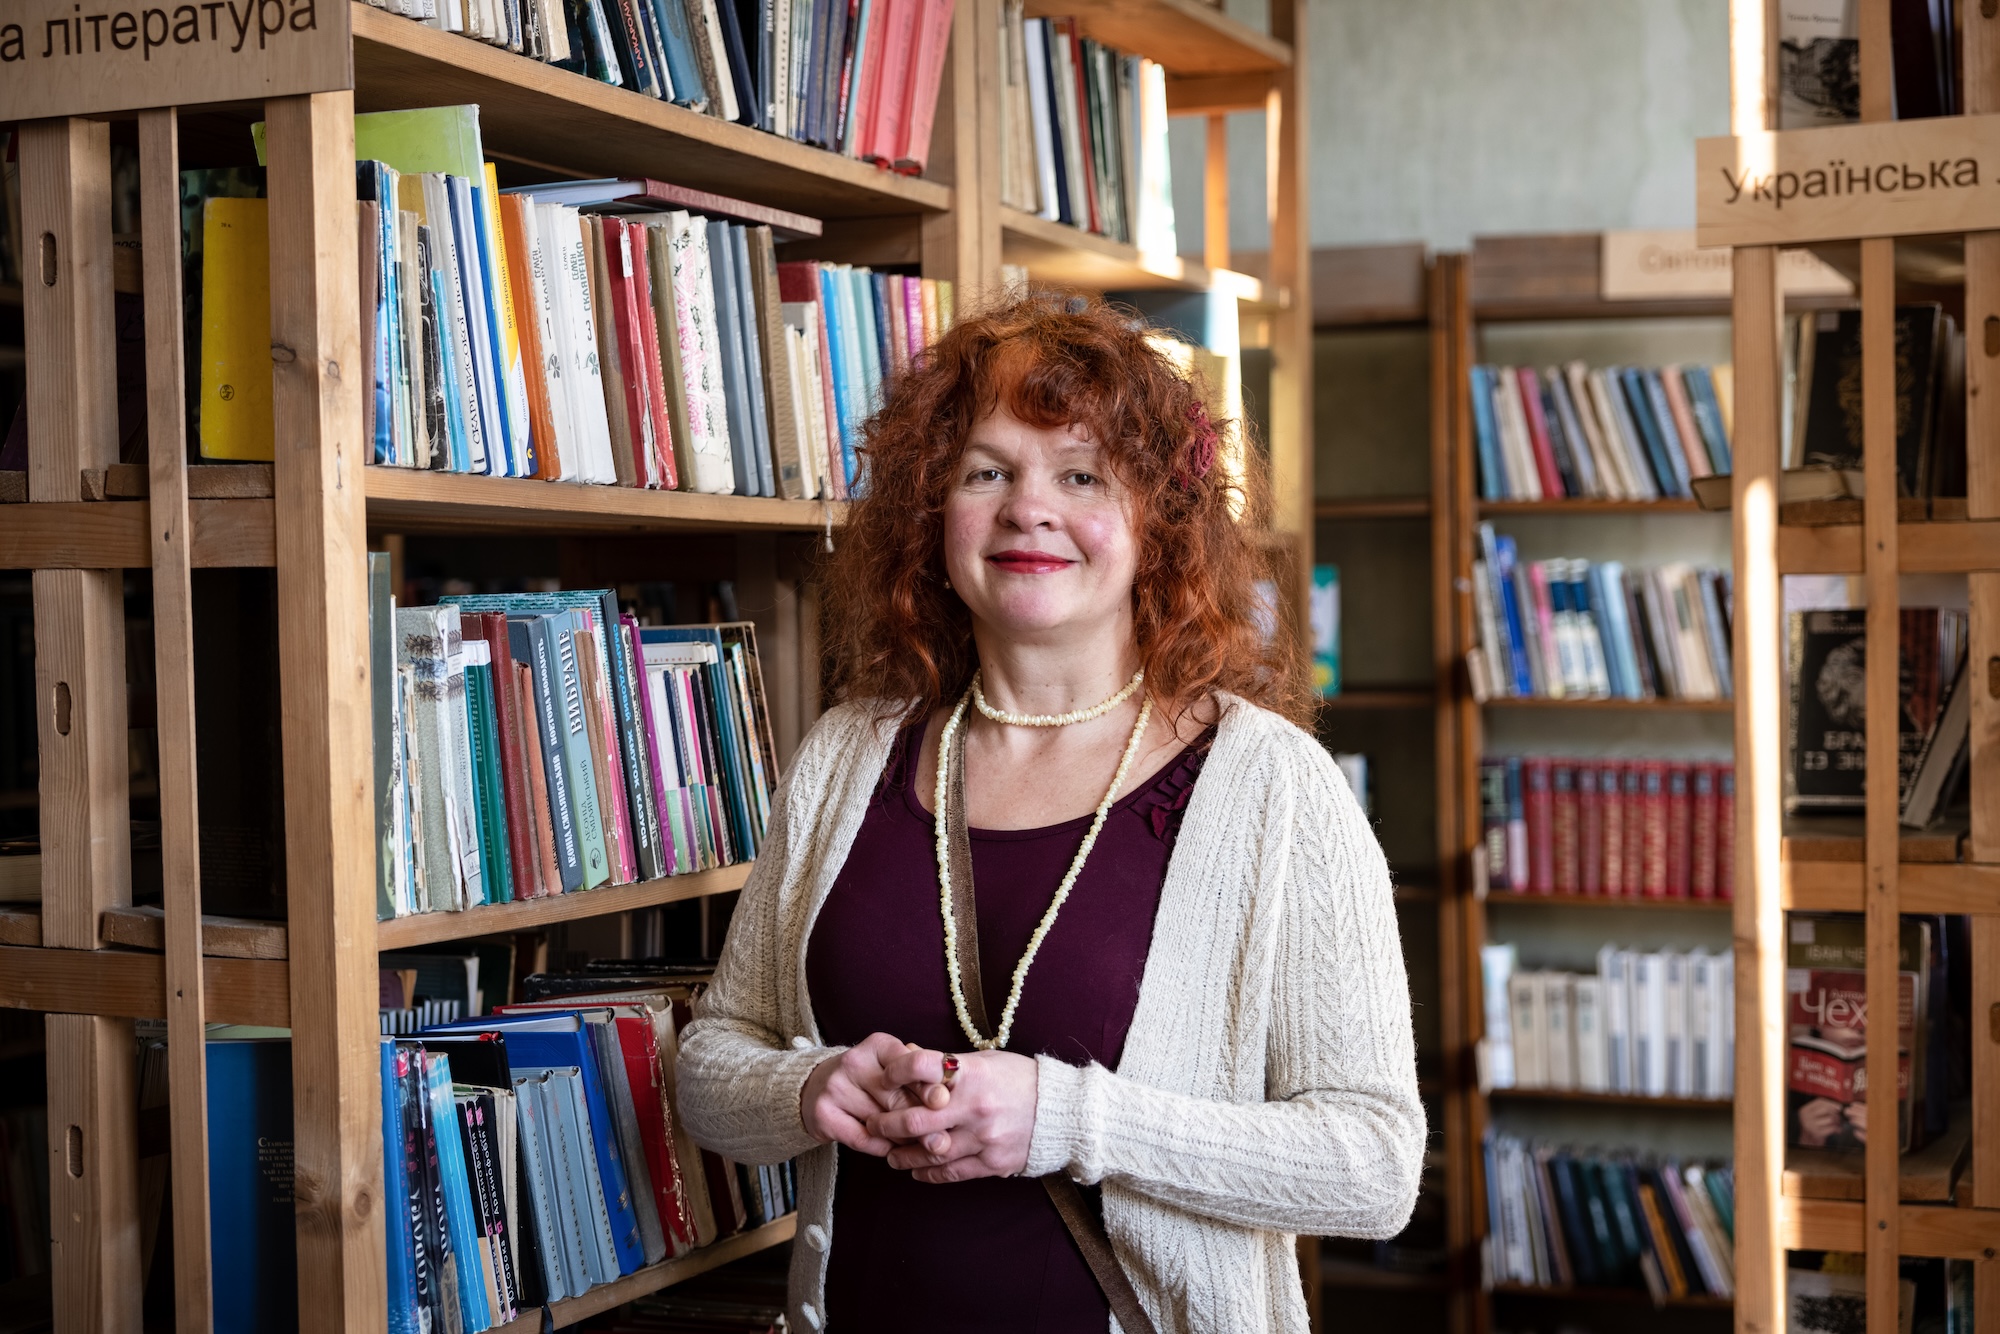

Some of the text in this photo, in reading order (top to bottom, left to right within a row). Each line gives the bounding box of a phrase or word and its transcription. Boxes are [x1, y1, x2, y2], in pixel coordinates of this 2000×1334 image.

[0, 0, 317, 62] а література
[621, 0, 645, 70] БАРКАРОЛИ
[1721, 156, 1980, 210] Українська
[531, 249, 542, 279] СЕМЕН
[569, 251, 579, 281] СЕМЕН
[575, 240, 591, 312] СКЛЯРЕНКО
[456, 316, 474, 387] ВИСОКОЇ
[507, 316, 514, 330] МИ
[586, 319, 593, 342] 3
[466, 392, 481, 445] СКАРБ
[520, 398, 528, 423] Уляна
[538, 637, 560, 746] ПОЕТОВА МОЛОДІСТЬ
[559, 628, 584, 737] ВИБРАНЕ
[612, 622, 632, 723] СМАРАГДОВИЙ
[626, 728, 641, 789] ЖМУТОК
[635, 791, 649, 850] КАЗУСІВ
[554, 755, 576, 869] ЛЕОНІД СМІЛЯНСЬКИЙ
[580, 800, 594, 842] ЛЕОНІД
[581, 759, 598, 841] СМІЛЯНСЬКИЙ
[471, 1132, 490, 1218] Арахнофобія
[533, 1131, 560, 1282] ВОЛОДИМИР СОСЮРА
[585, 1120, 617, 1264] ВОЛОДИМИР СОСЮРА
[410, 1186, 427, 1296] СОРОКА
[434, 1183, 449, 1265] ОРОКА
[480, 1130, 515, 1302] Ю.Сорока Арахнофобія
[569, 1188, 587, 1277] ВОЛОДИМИР
